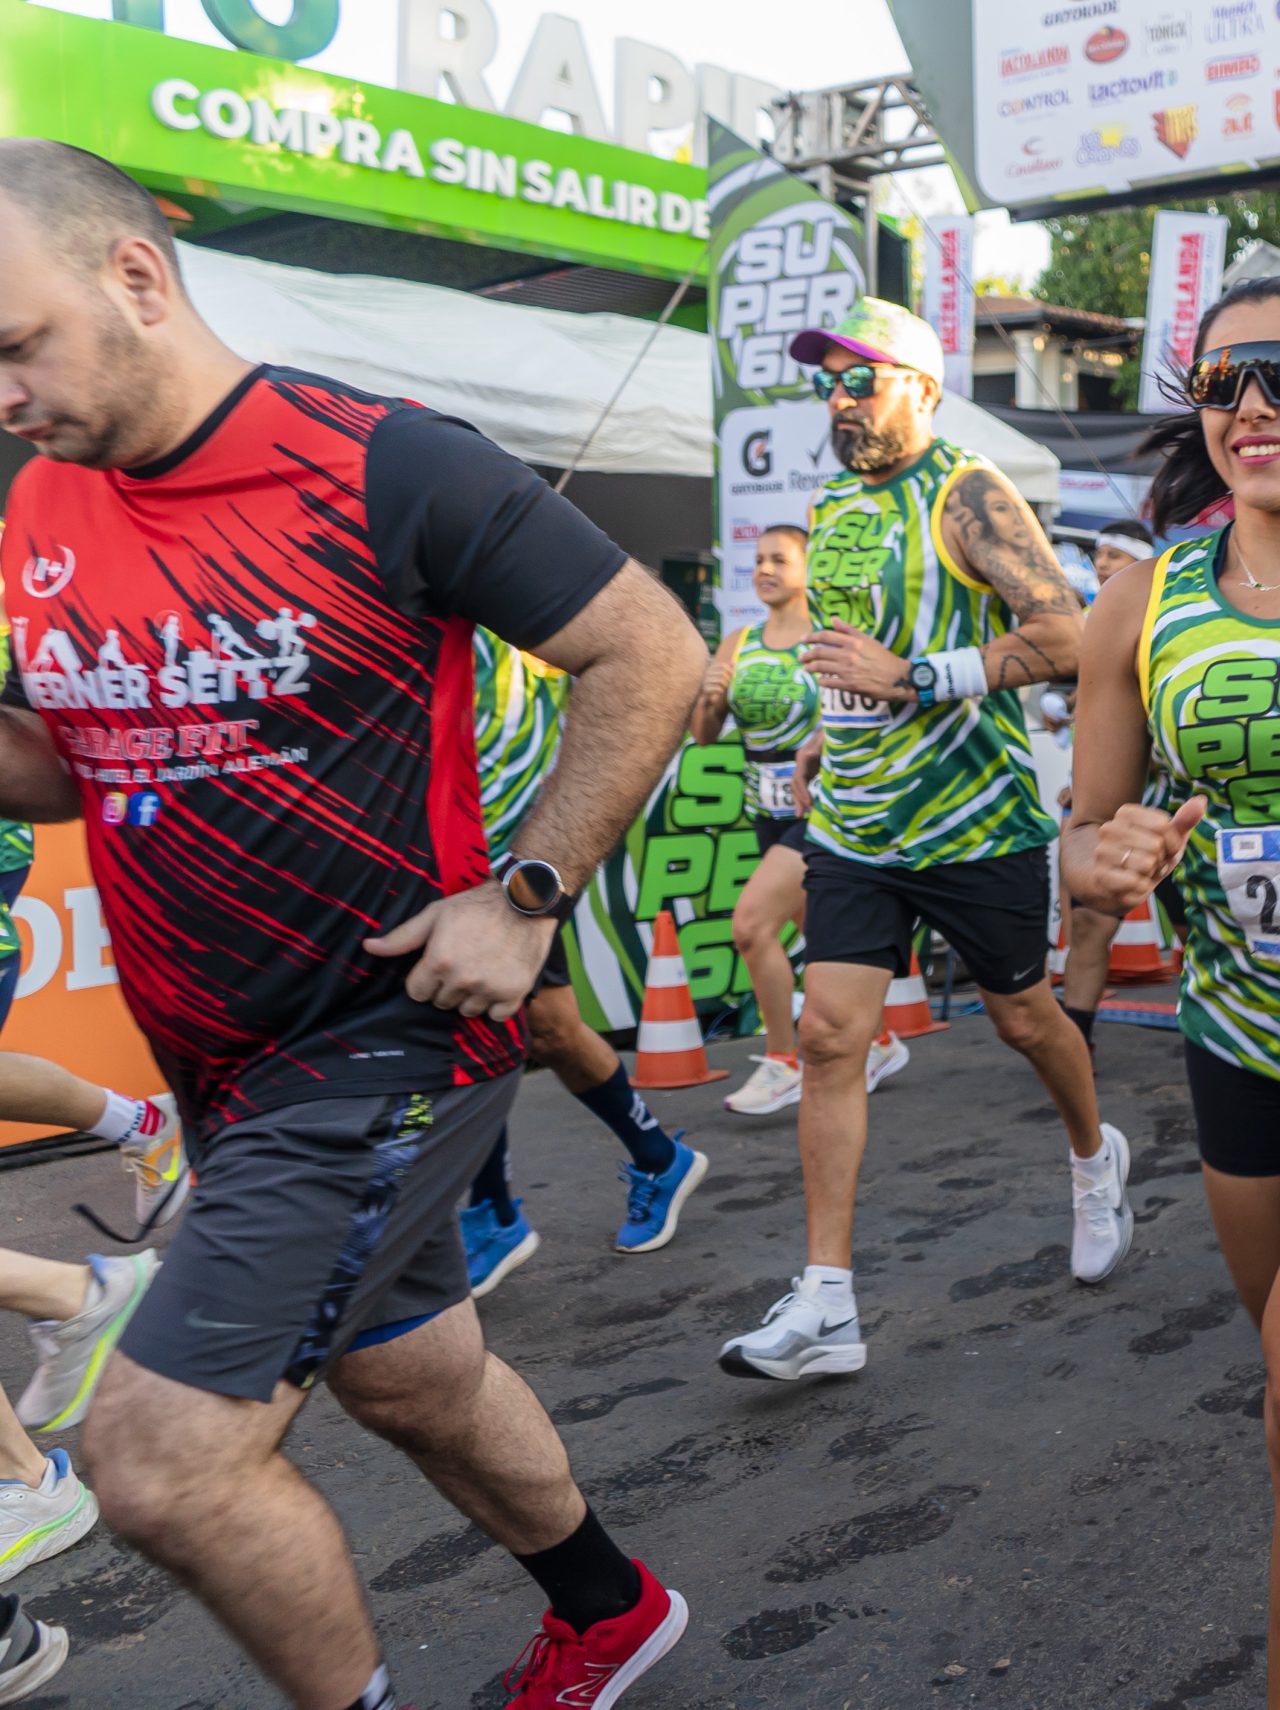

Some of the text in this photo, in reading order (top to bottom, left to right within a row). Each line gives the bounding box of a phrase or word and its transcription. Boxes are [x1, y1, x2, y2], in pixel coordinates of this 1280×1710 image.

[151, 78, 426, 178] COMPRA
[429, 138, 518, 198] SIN
[522, 160, 657, 228] SALIR
[734, 217, 835, 284] SU
[719, 270, 856, 340] PER
[826, 510, 902, 549] SU
[808, 547, 895, 590] PER
[176, 719, 259, 757] FIT
[672, 743, 746, 829] S
[635, 828, 762, 922] PE
